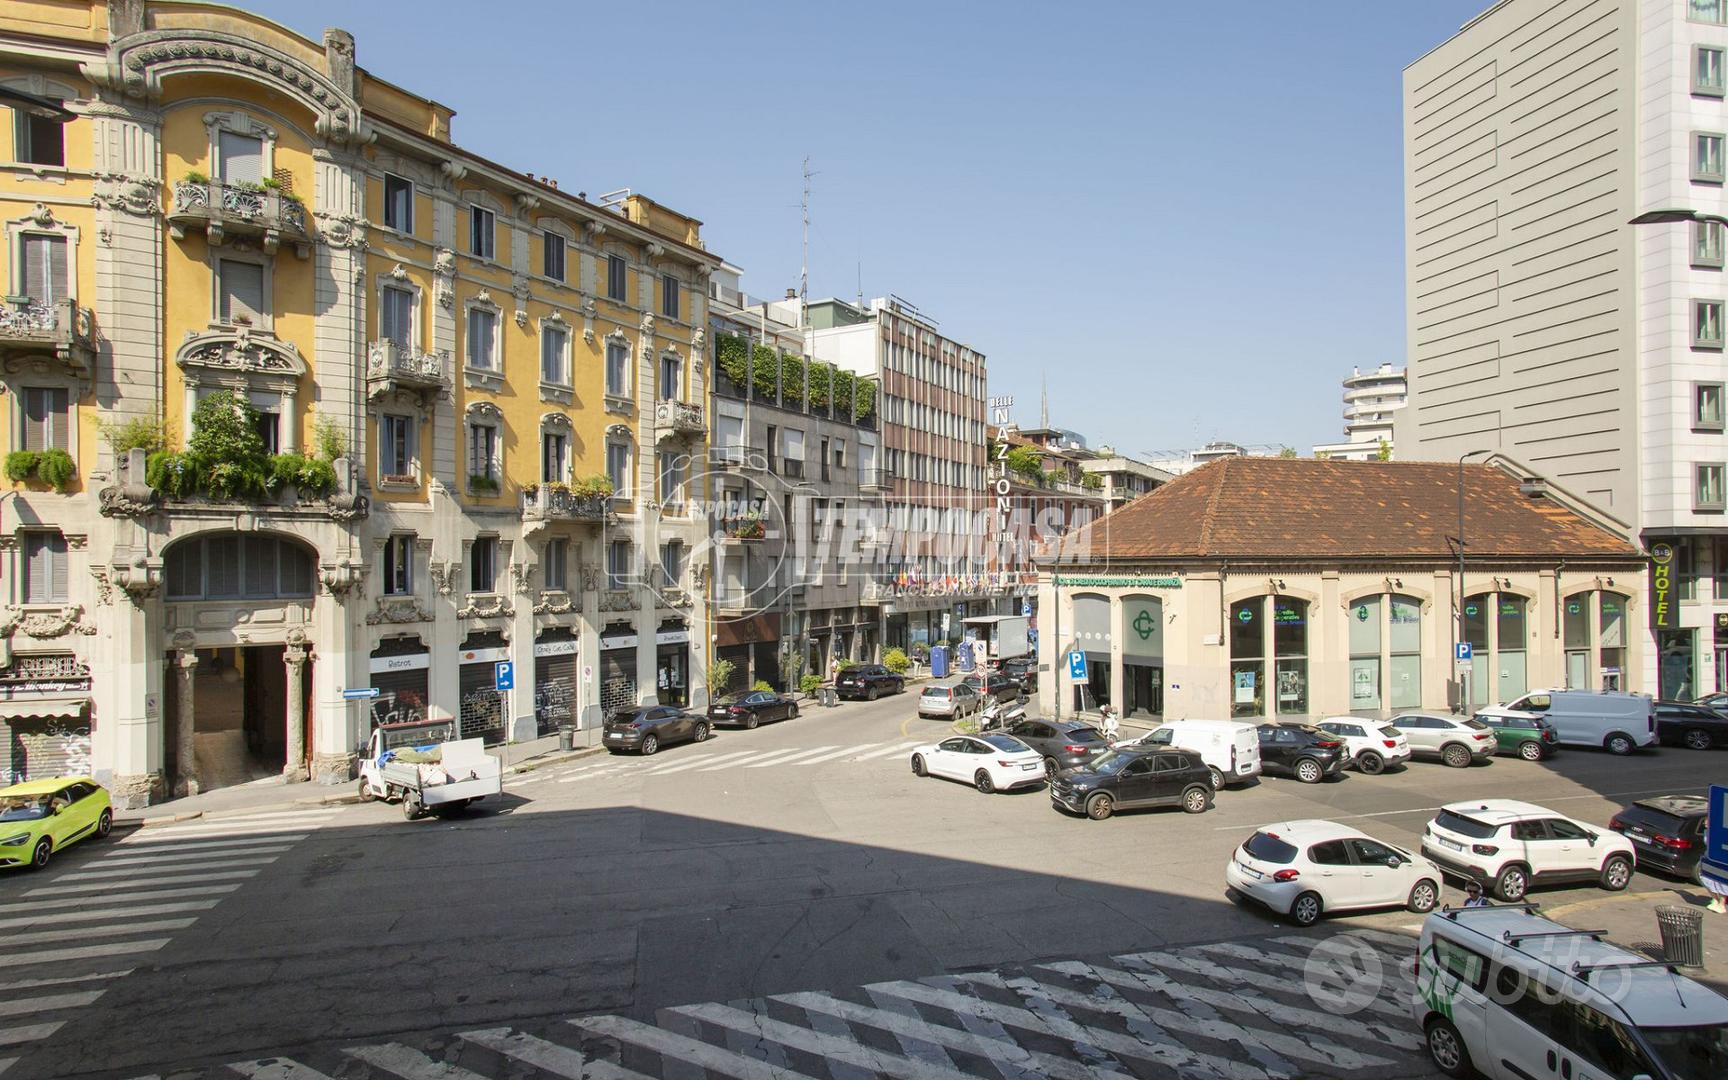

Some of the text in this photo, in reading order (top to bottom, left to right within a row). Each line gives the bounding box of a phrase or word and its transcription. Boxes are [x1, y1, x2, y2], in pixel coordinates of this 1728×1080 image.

[991, 396, 1014, 407] DELLE
[996, 409, 1011, 530] NAZIONI
[1655, 566, 1670, 626] HOTEL
[1459, 645, 1468, 657] P
[1072, 653, 1081, 666] P
[499, 664, 509, 678] P
